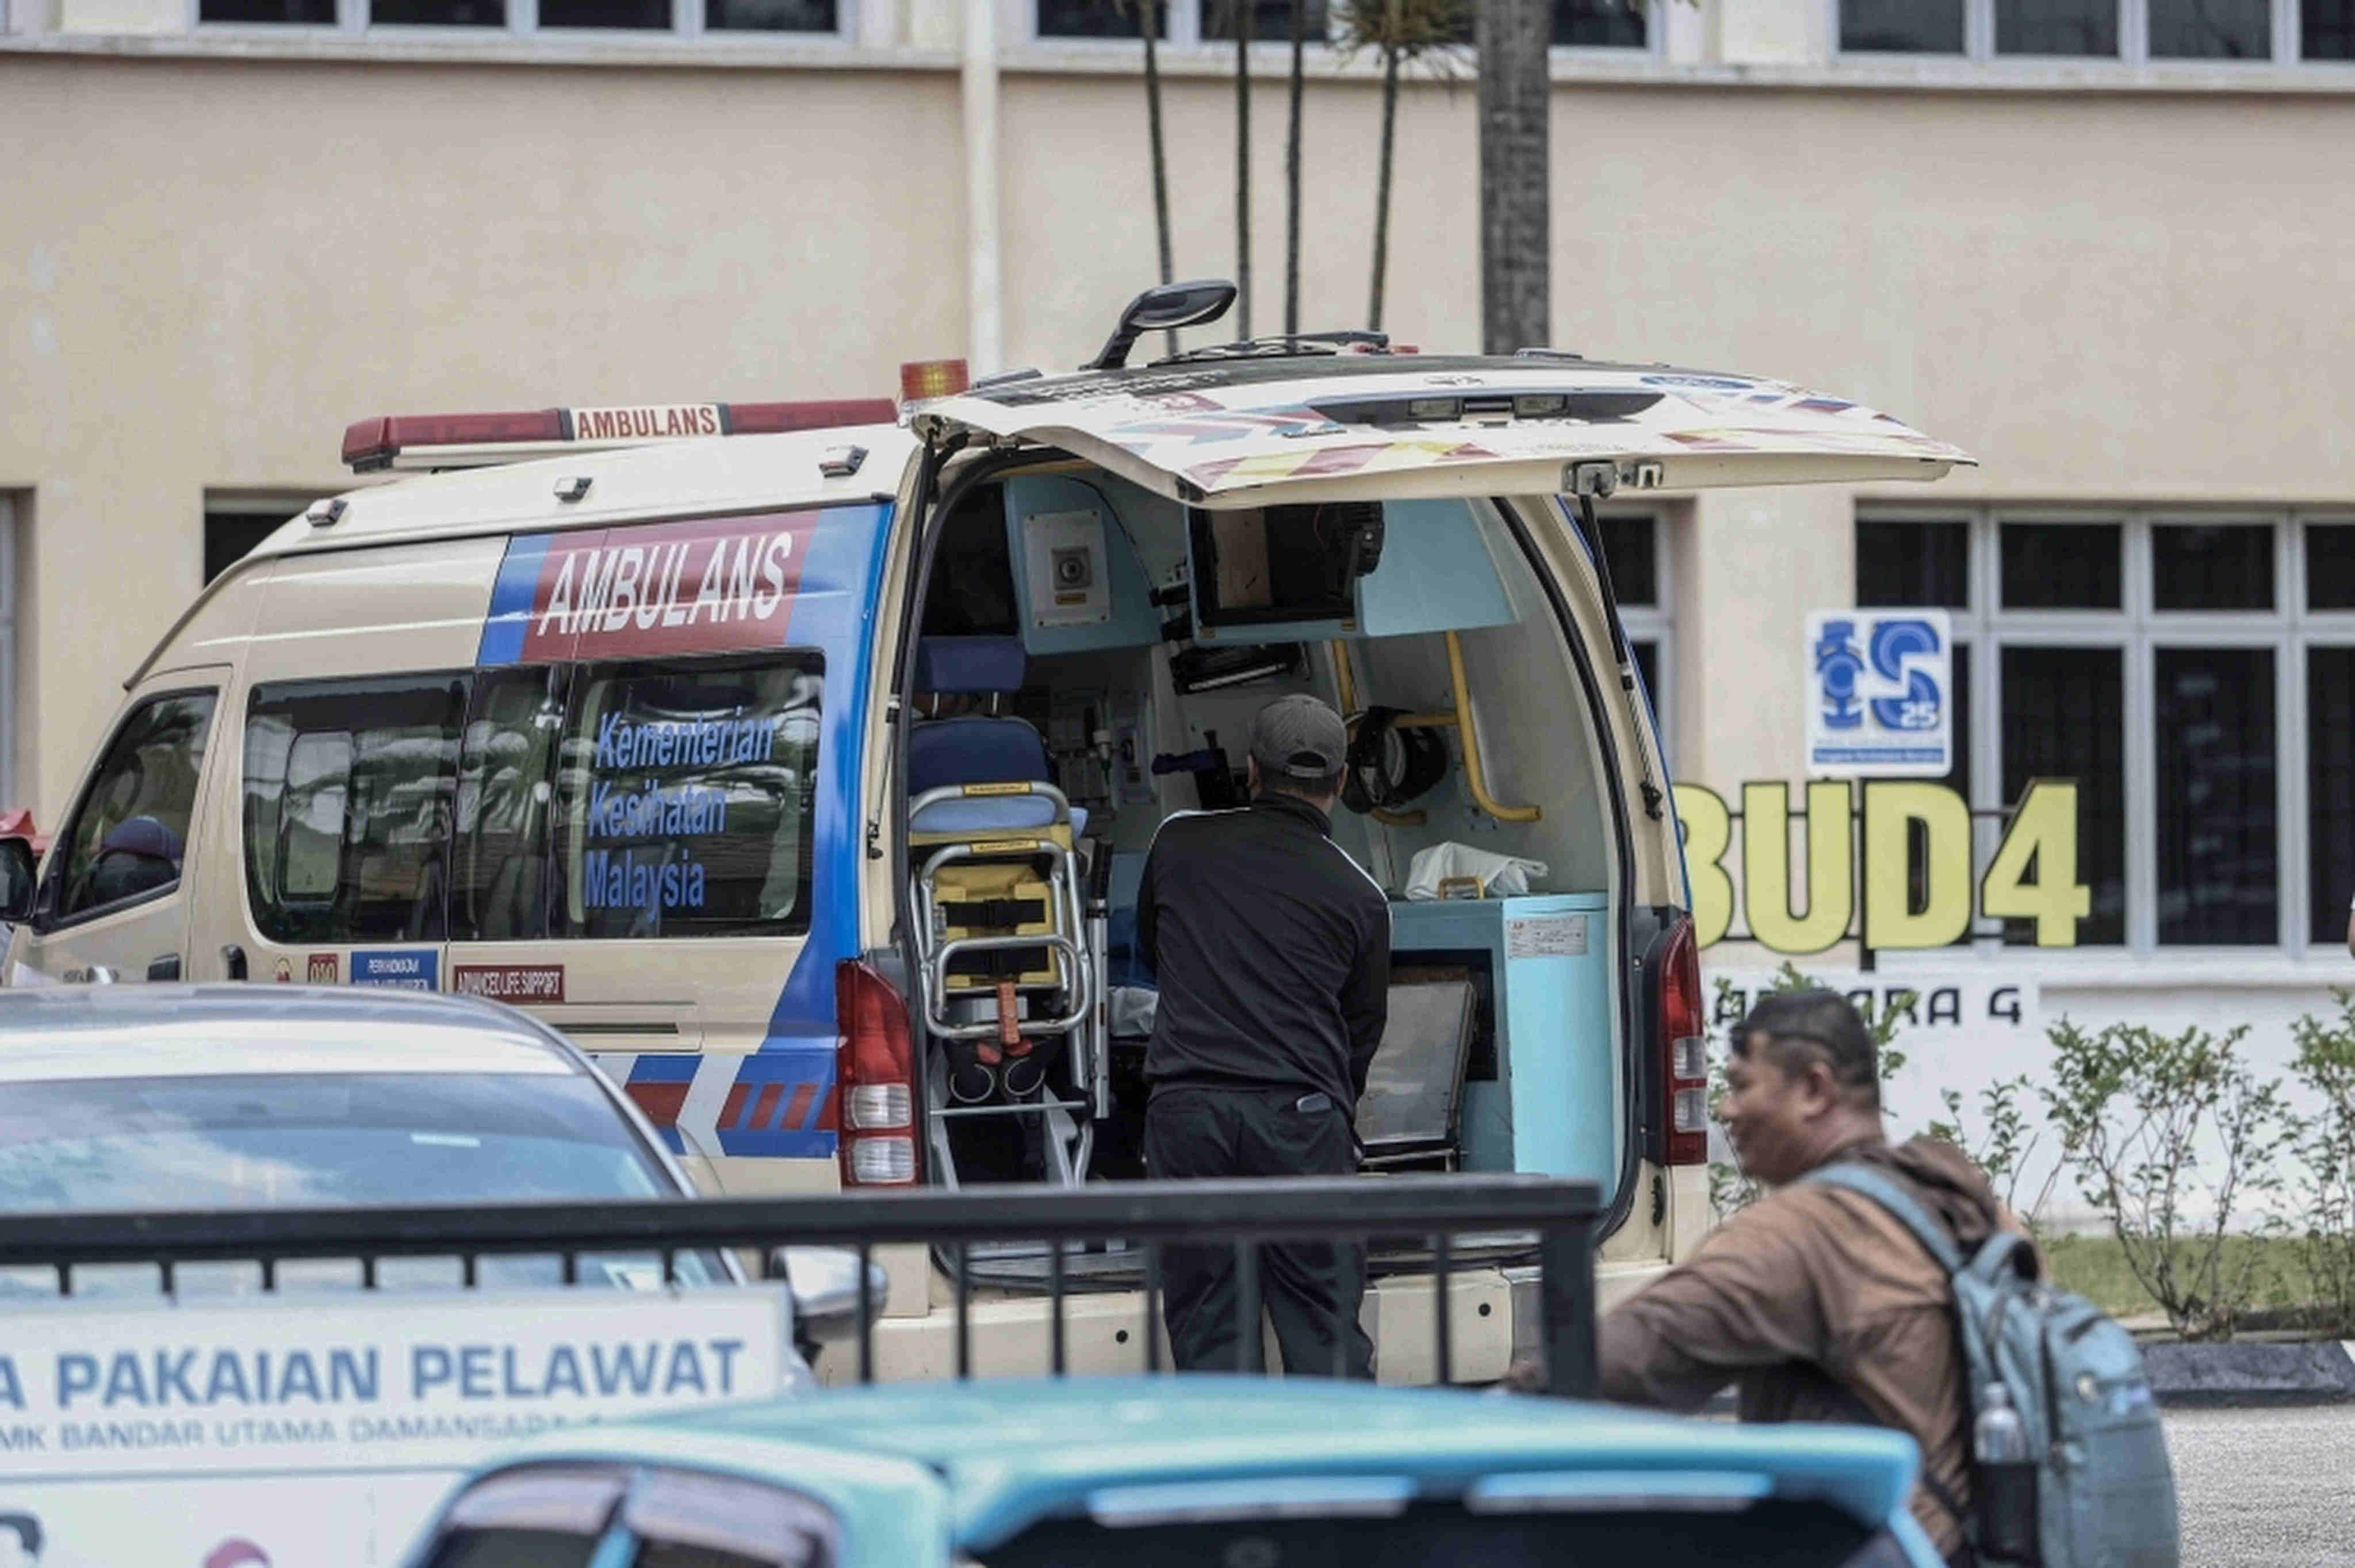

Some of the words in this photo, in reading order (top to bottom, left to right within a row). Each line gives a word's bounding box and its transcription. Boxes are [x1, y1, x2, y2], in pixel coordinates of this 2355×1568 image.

[578, 407, 717, 439] AMBULANS
[537, 531, 792, 637] AMBULANS
[596, 706, 774, 768] Kementerian
[1901, 701, 1939, 728] 25
[588, 781, 726, 837] Kesihatan
[584, 850, 705, 923] Malaysia
[58, 1348, 378, 1408] PAKAIAN
[412, 1340, 744, 1400] PELAWAT
[59, 1419, 205, 1449] BANDAR
[215, 1416, 336, 1446] UTAMA
